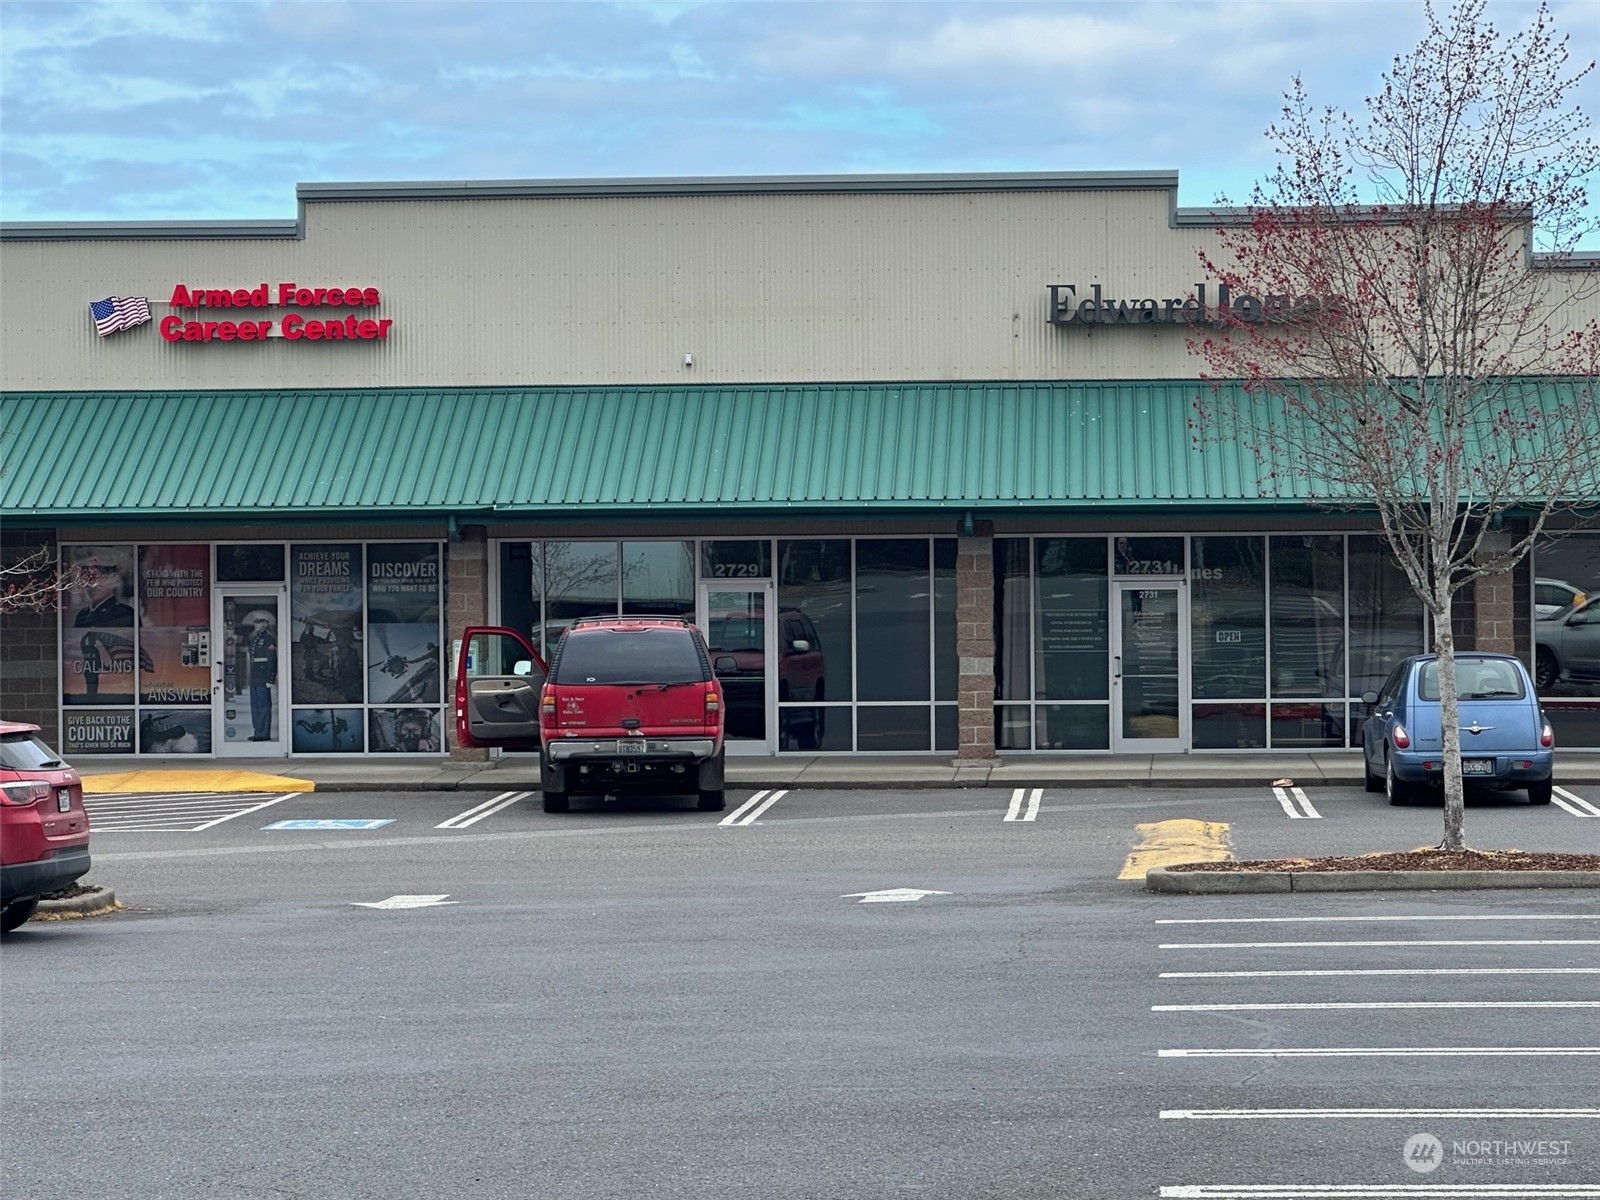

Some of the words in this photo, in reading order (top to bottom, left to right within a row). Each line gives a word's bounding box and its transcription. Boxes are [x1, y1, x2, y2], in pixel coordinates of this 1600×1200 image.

[169, 283, 269, 308] Armed
[278, 283, 380, 307] Forces
[1046, 283, 1206, 324] Edward
[160, 315, 273, 342] Career
[281, 313, 393, 340] Center
[299, 552, 329, 560] ACHIEVE
[332, 552, 350, 560] YOUR
[146, 569, 169, 578] STAND
[171, 569, 189, 578] WITH
[191, 569, 204, 578] THE
[299, 561, 350, 576] DREAMS
[372, 562, 437, 577] DISCOVER
[715, 563, 759, 577] 2729
[1129, 560, 1172, 574] 2731
[146, 579, 160, 587] FEW
[162, 579, 176, 587] WHO
[177, 579, 203, 587] PROTECT
[371, 584, 387, 592] WHO
[387, 584, 400, 592] YOU
[400, 584, 418, 592] WANT
[419, 584, 427, 592] TO
[428, 584, 437, 592] BE
[146, 587, 164, 598] OUR
[166, 587, 204, 598] COUNTRY
[1139, 590, 1158, 599] 2731
[1218, 631, 1240, 641] OPEN
[73, 659, 132, 674] CALLING
[147, 687, 209, 702] ANSWER
[68, 716, 85, 725] GIVE
[86, 716, 106, 725] BACK
[106, 716, 116, 725] TO
[117, 716, 131, 725] THE
[68, 726, 131, 741] COUNTRY
